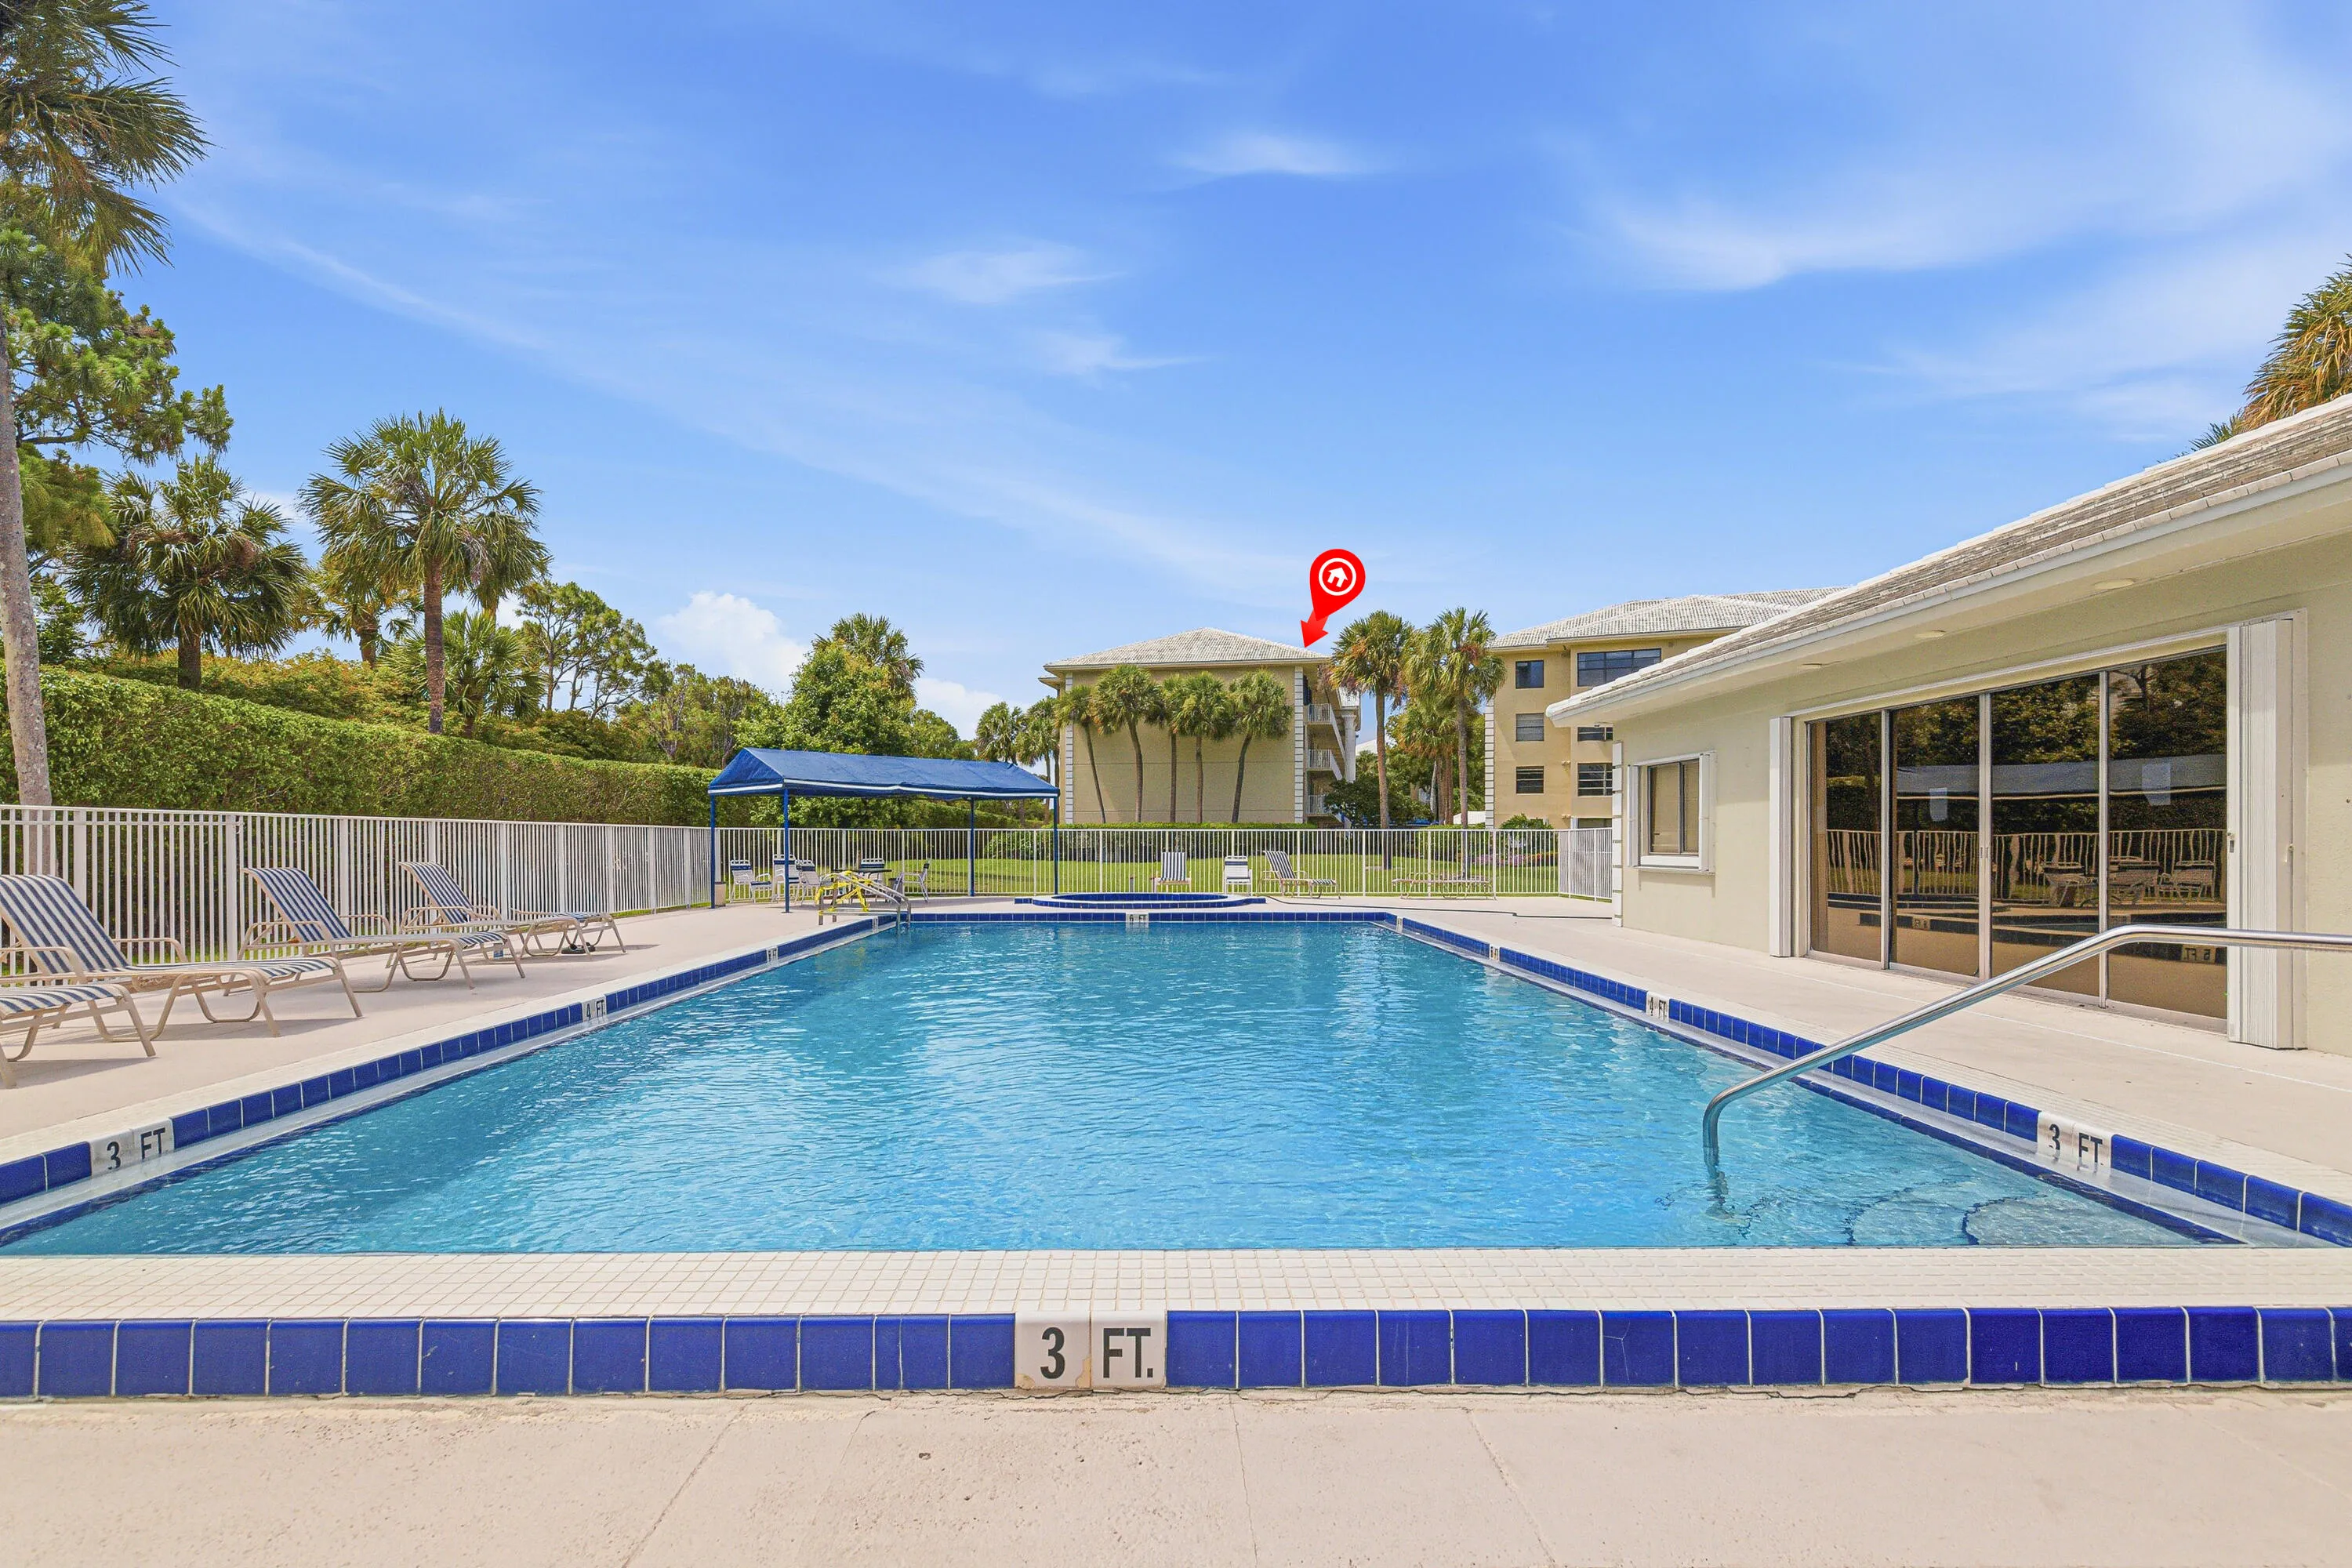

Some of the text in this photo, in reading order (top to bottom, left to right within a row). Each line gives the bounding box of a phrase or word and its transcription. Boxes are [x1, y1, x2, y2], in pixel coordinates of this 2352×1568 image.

[586, 1003, 591, 1020] 4
[107, 1127, 166, 1171] 3 FT
[2049, 1123, 2060, 1152] 3
[1040, 1327, 1153, 1379] 3 FT.
